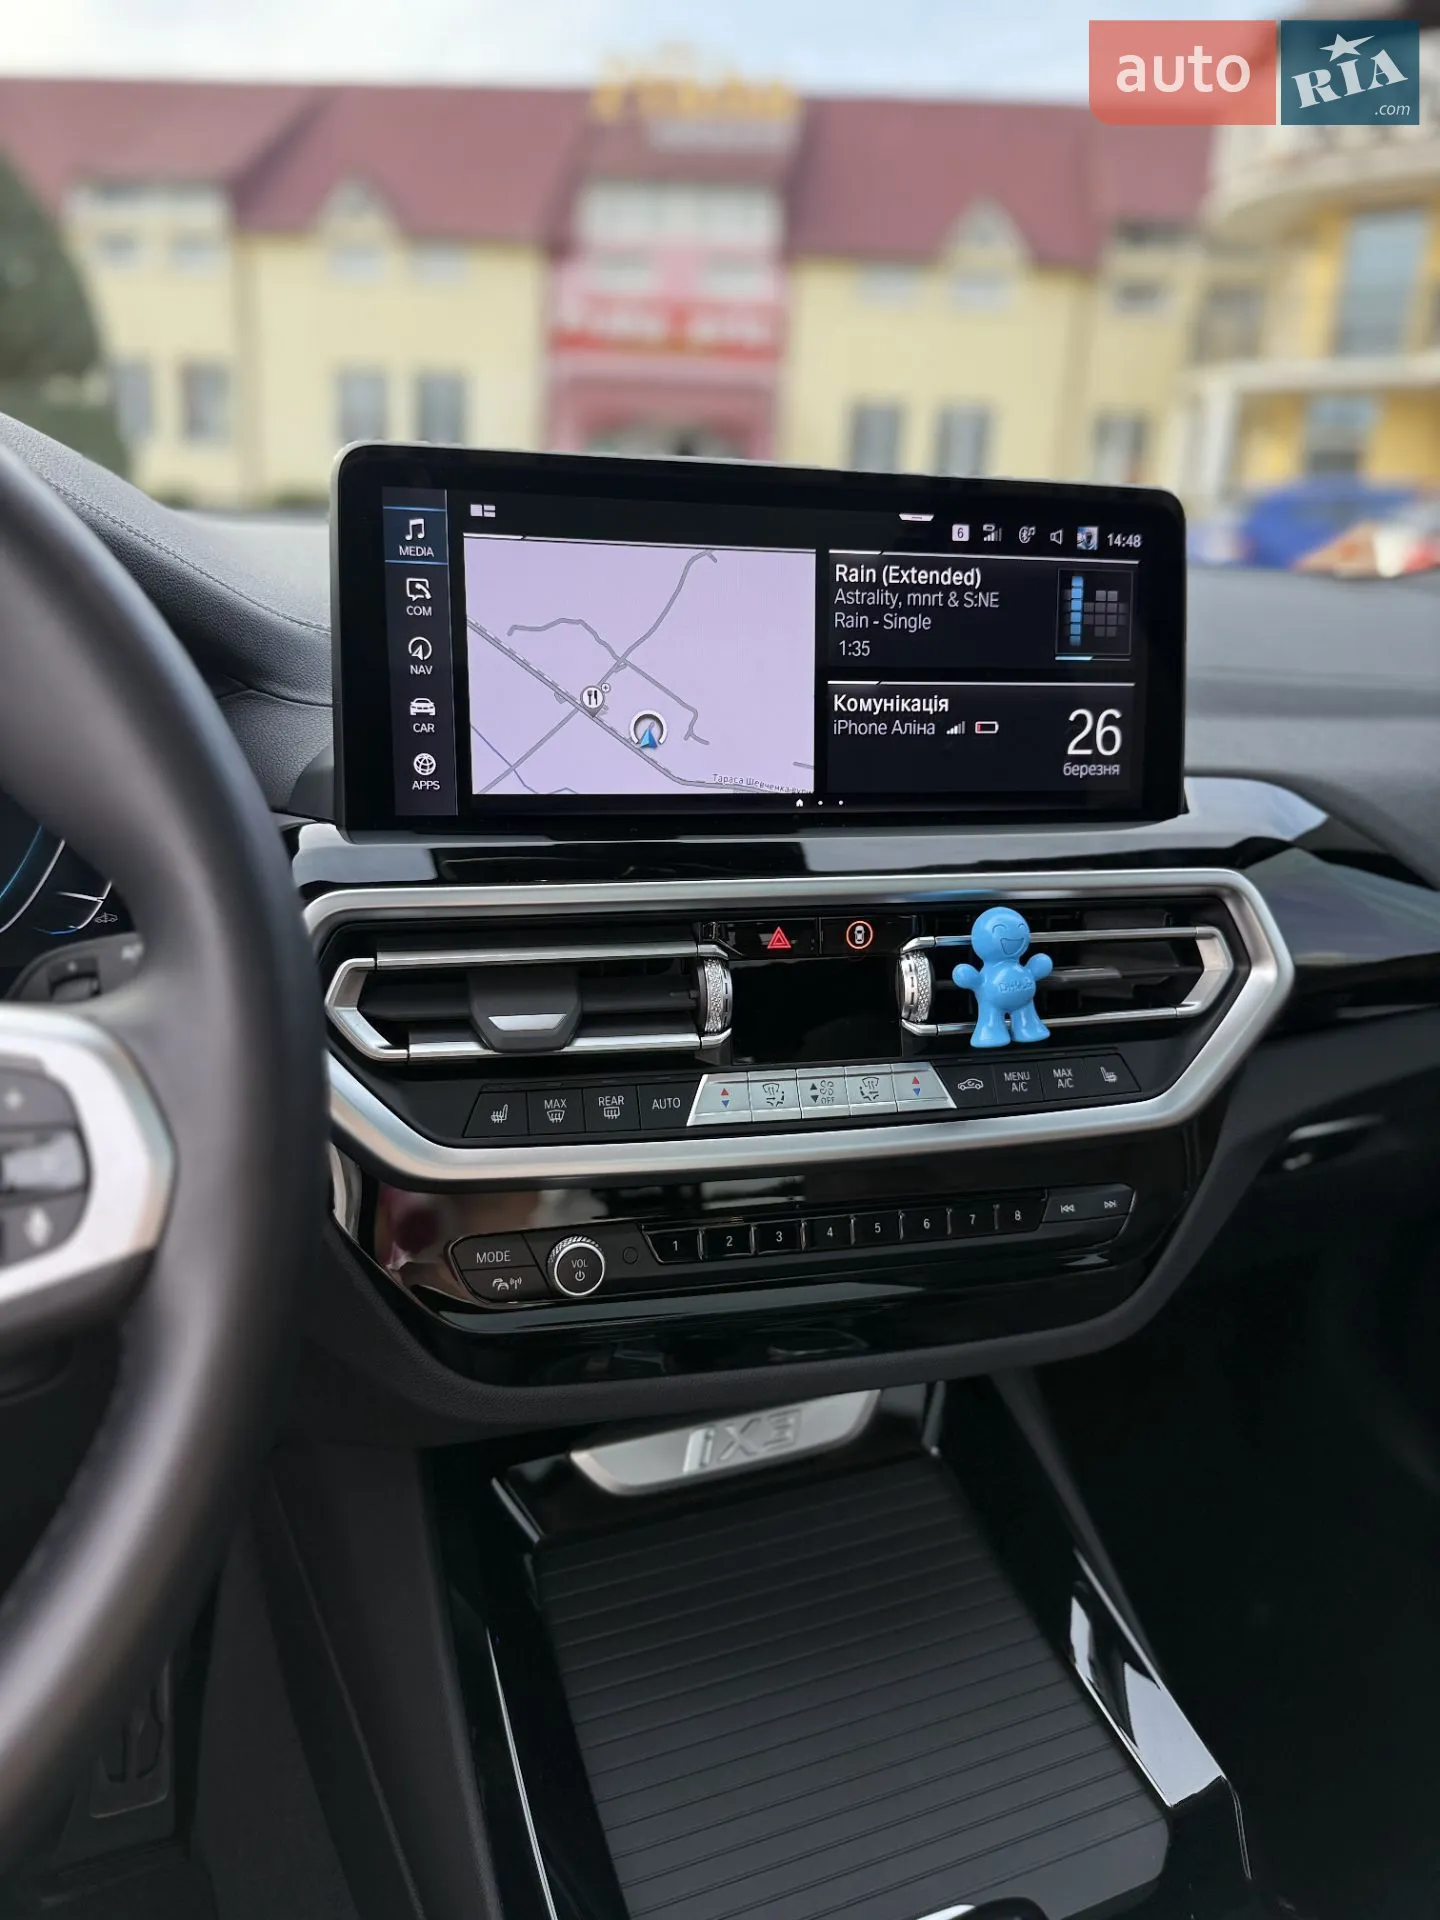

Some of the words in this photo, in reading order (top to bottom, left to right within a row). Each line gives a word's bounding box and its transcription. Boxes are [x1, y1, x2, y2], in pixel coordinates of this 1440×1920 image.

[1107, 532, 1142, 549] 14:48
[399, 545, 434, 557] MEDIA
[835, 563, 876, 583] Rain
[882, 565, 981, 587] (Extended)
[834, 587, 902, 608] Astrality,
[907, 591, 944, 607] mnrt
[948, 592, 959, 607] &
[963, 591, 1000, 608] S:NE
[406, 605, 433, 616] COM
[834, 612, 869, 629] Rain
[883, 613, 931, 632] Single
[839, 639, 870, 656] 1:35
[410, 664, 433, 675] NAV
[833, 694, 949, 714] Комунікація
[412, 723, 435, 733] CAR
[833, 719, 887, 735] iPhone
[891, 719, 936, 735] Аліна
[1066, 708, 1123, 756] 26
[1063, 762, 1120, 778] березня
[712, 773, 744, 784] Тараса
[411, 780, 441, 790] APPS
[1004, 1071, 1030, 1082] MENU
[1052, 1068, 1073, 1078] MAX
[1011, 1081, 1028, 1092] A/C
[1057, 1078, 1074, 1088] A/C
[544, 1099, 567, 1109] MAX
[598, 1096, 625, 1106] REAR
[652, 1097, 681, 1110] AUTO
[821, 1096, 835, 1104] OFF
[969, 1214, 976, 1225] 7
[1014, 1210, 1021, 1221] 8
[874, 1222, 882, 1234] 5
[923, 1218, 931, 1229] 6
[775, 1231, 783, 1242] 3
[826, 1227, 833, 1237] 4
[673, 1240, 678, 1251] 1
[726, 1236, 733, 1247] 2
[476, 1250, 511, 1264] MODE
[571, 1259, 589, 1269] VOL
[698, 1408, 802, 1467] iX3
